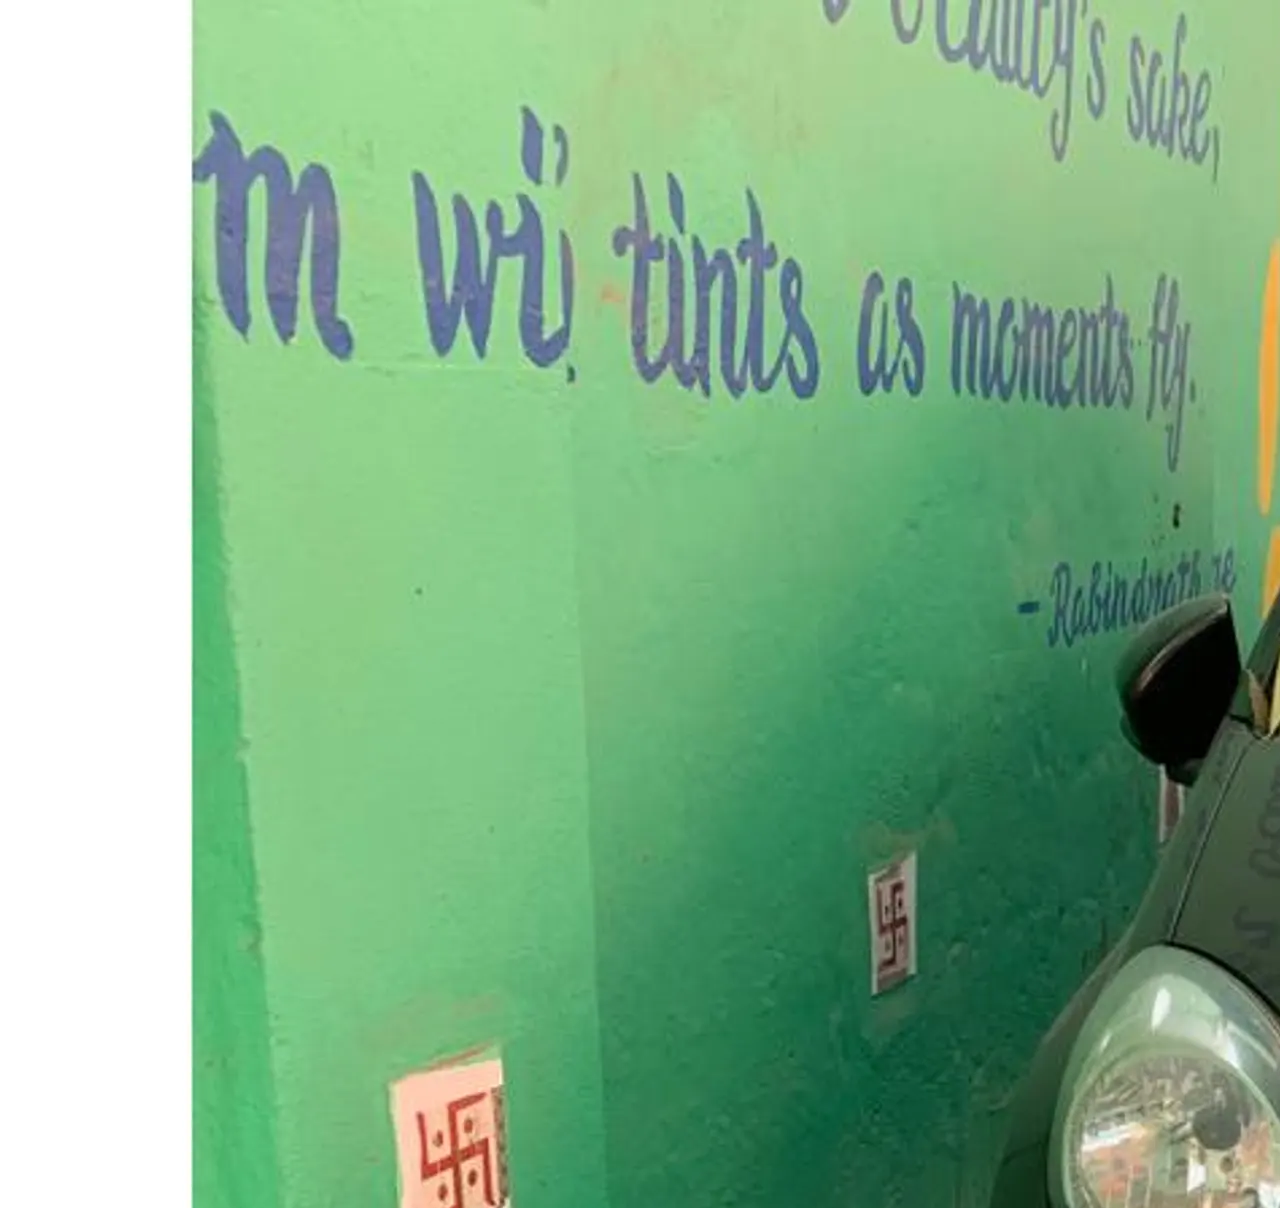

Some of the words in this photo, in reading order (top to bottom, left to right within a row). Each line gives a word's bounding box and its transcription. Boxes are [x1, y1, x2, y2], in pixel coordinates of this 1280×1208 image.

[1127, 13, 1220, 184] sake,
[612, 170, 820, 400] tints
[857, 270, 926, 397] as
[951, 272, 1134, 411] moments
[1145, 272, 1196, 473] fly.
